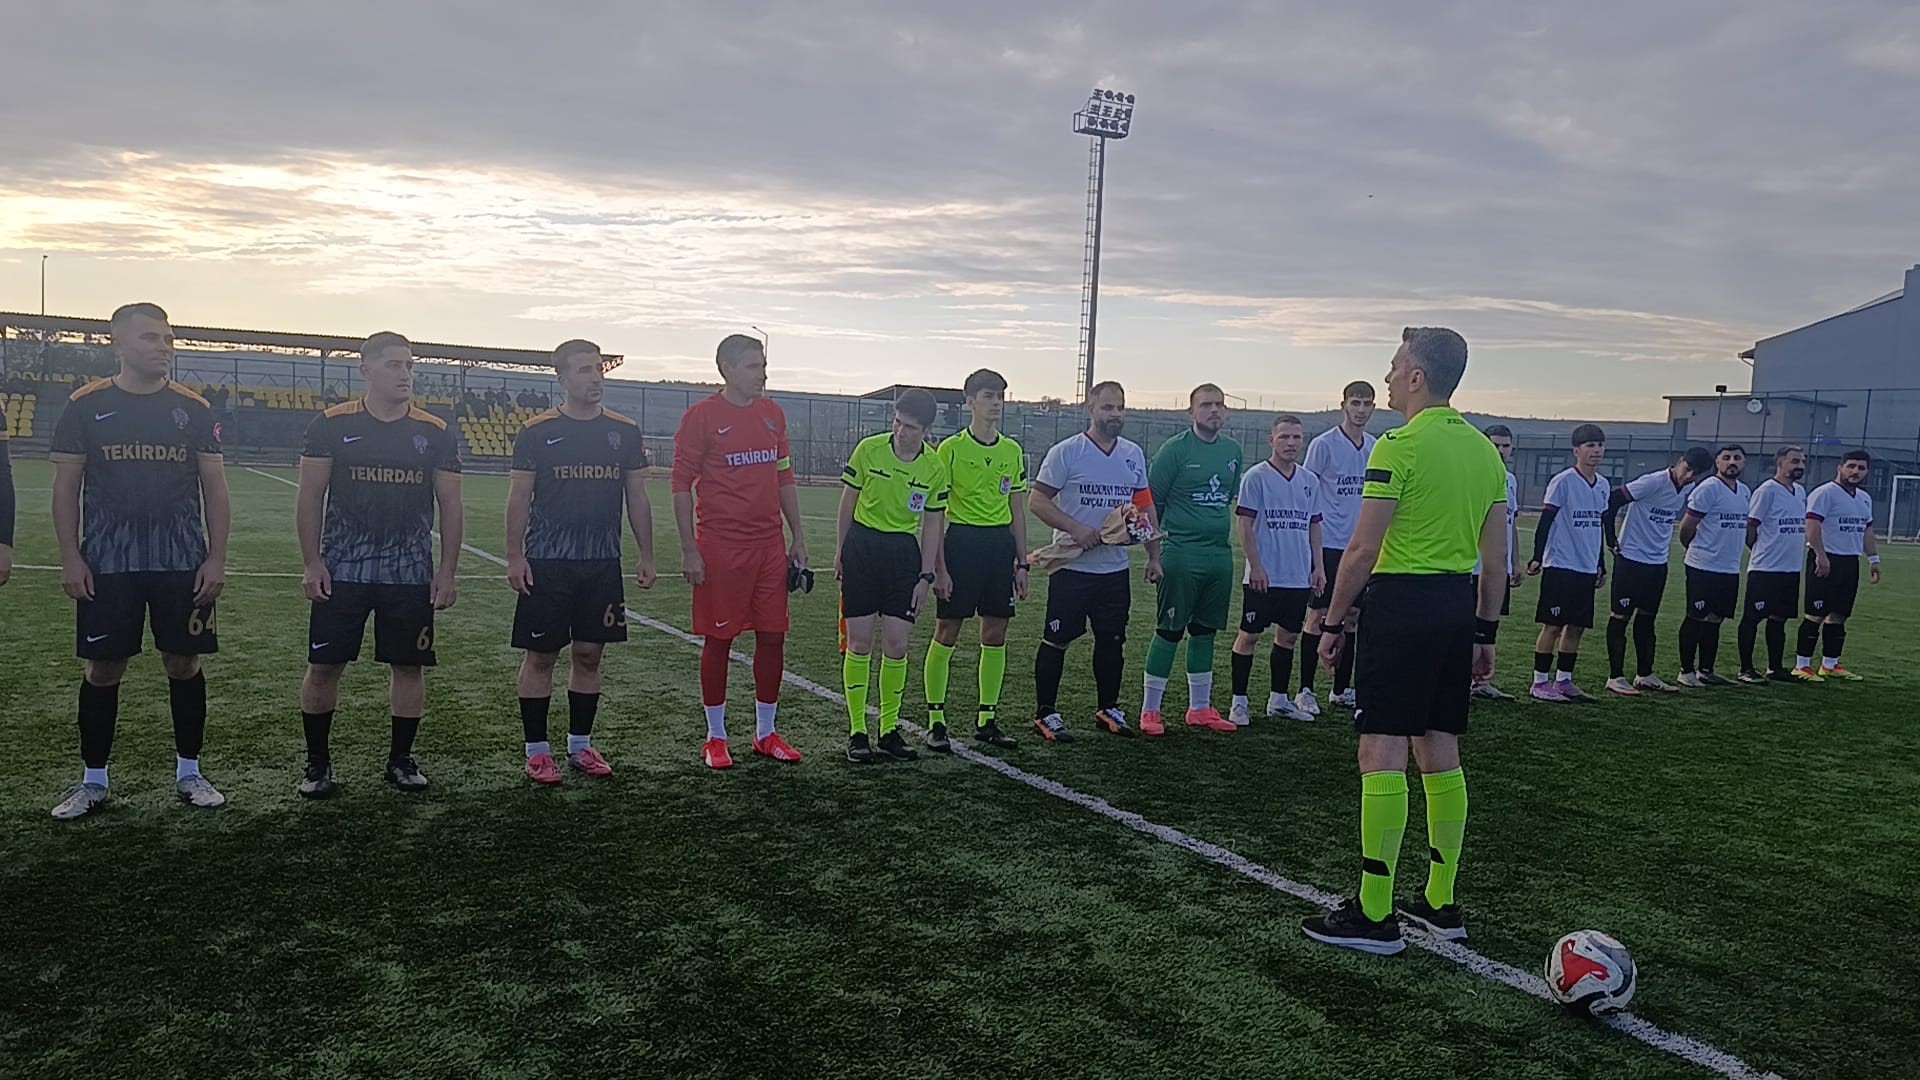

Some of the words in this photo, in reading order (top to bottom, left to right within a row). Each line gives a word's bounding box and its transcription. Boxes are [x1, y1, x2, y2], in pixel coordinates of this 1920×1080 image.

[101, 441, 188, 462] TEKİRDAĞ
[553, 462, 621, 480] TEKİRDAĞ
[189, 606, 216, 636] 64
